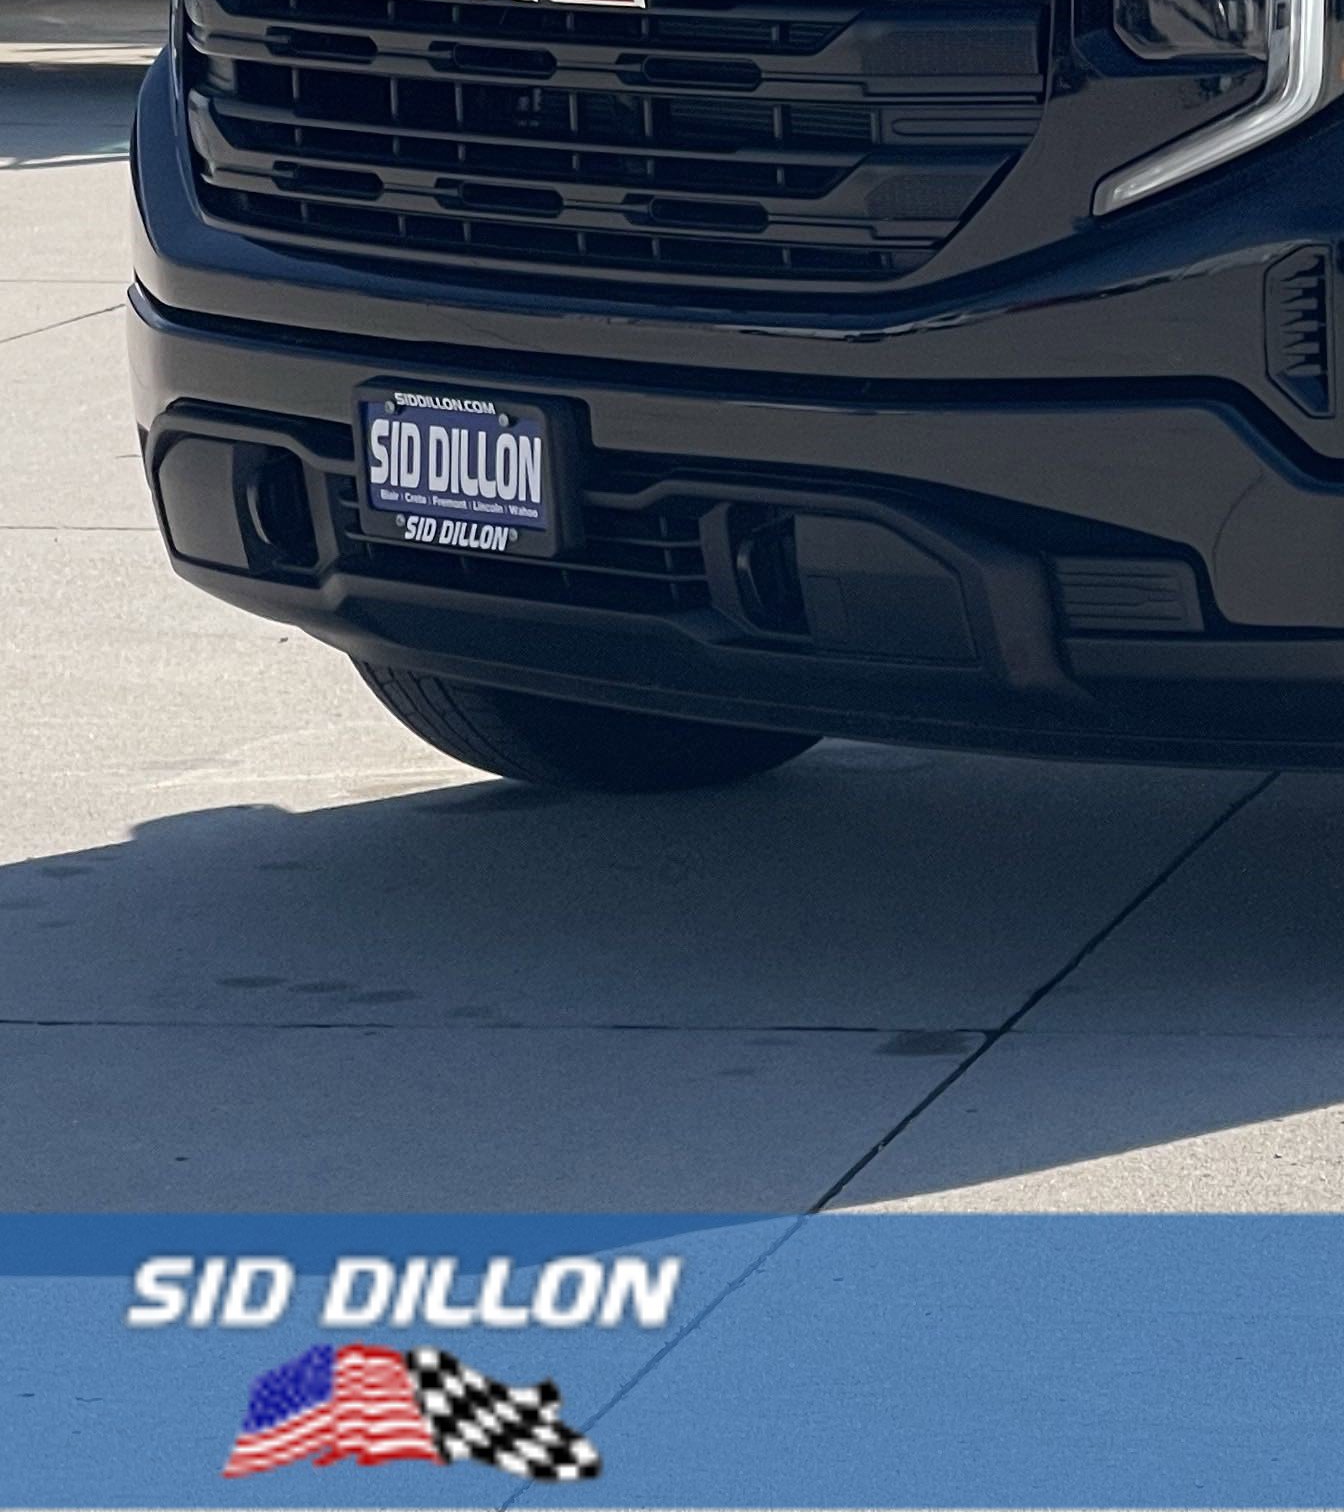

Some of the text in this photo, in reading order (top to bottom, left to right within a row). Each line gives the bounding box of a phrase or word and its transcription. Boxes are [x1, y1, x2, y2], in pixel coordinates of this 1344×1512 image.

[394, 392, 496, 415] SIDDILLON.COM
[370, 419, 542, 503] SID DILLON
[405, 516, 509, 551] SID DILLON
